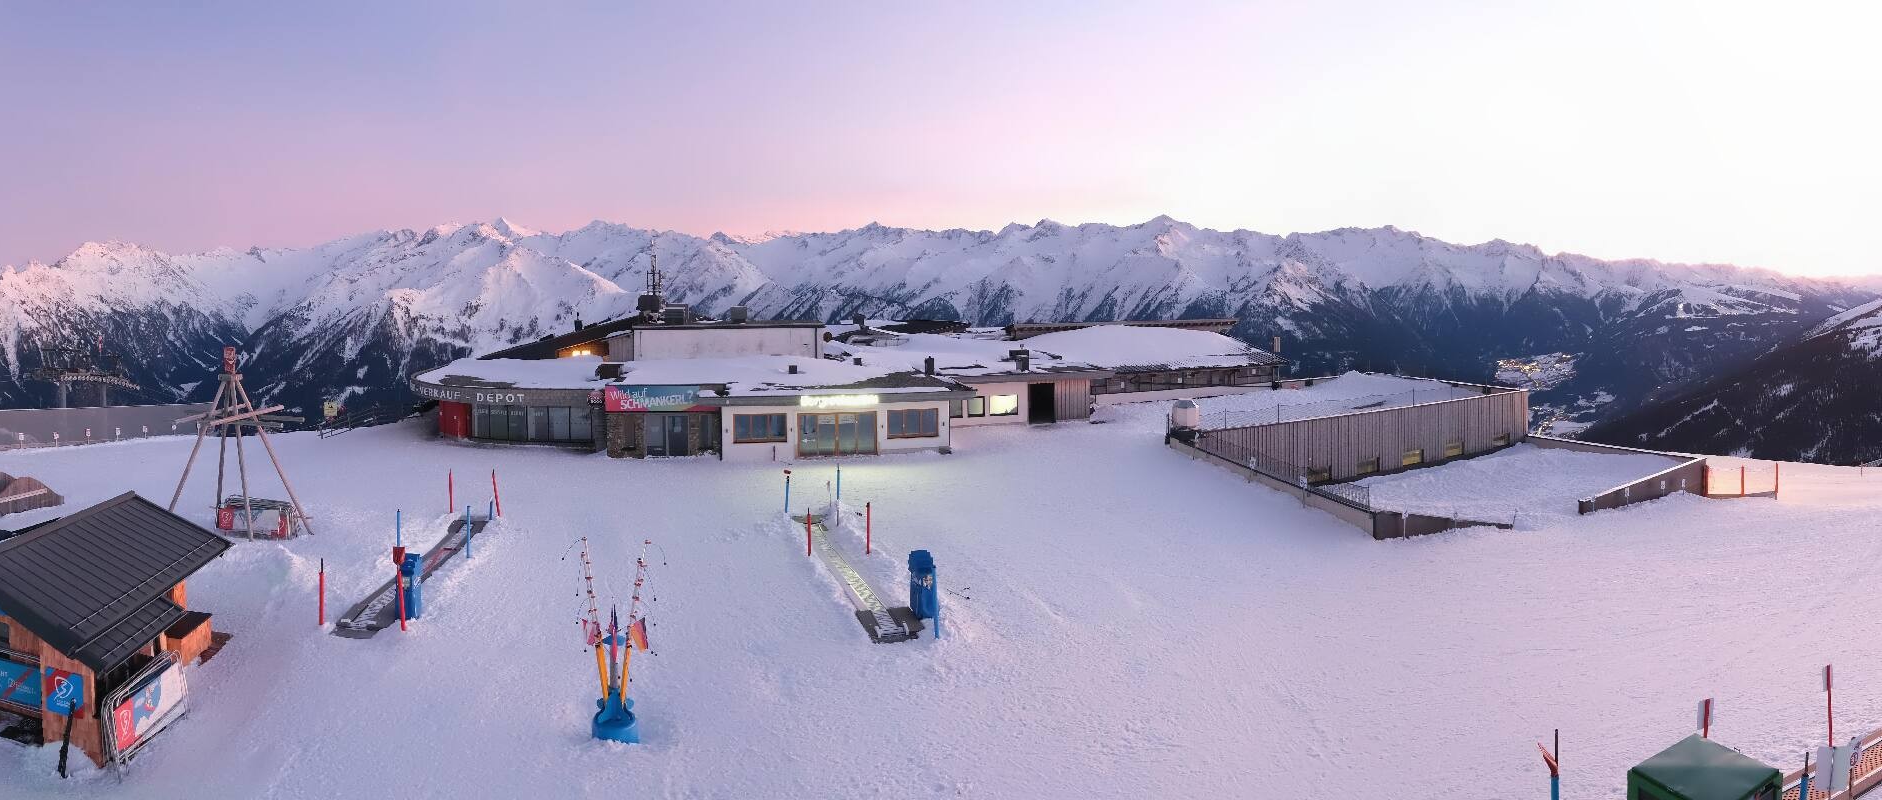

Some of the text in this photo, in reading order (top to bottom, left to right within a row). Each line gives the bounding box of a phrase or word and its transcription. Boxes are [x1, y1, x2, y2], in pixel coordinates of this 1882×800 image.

[419, 385, 461, 400] VERKAUF
[476, 392, 525, 403] DEPOT
[609, 389, 631, 401] Wild
[632, 387, 647, 399] auf
[620, 390, 694, 410] SCHMANKERL?
